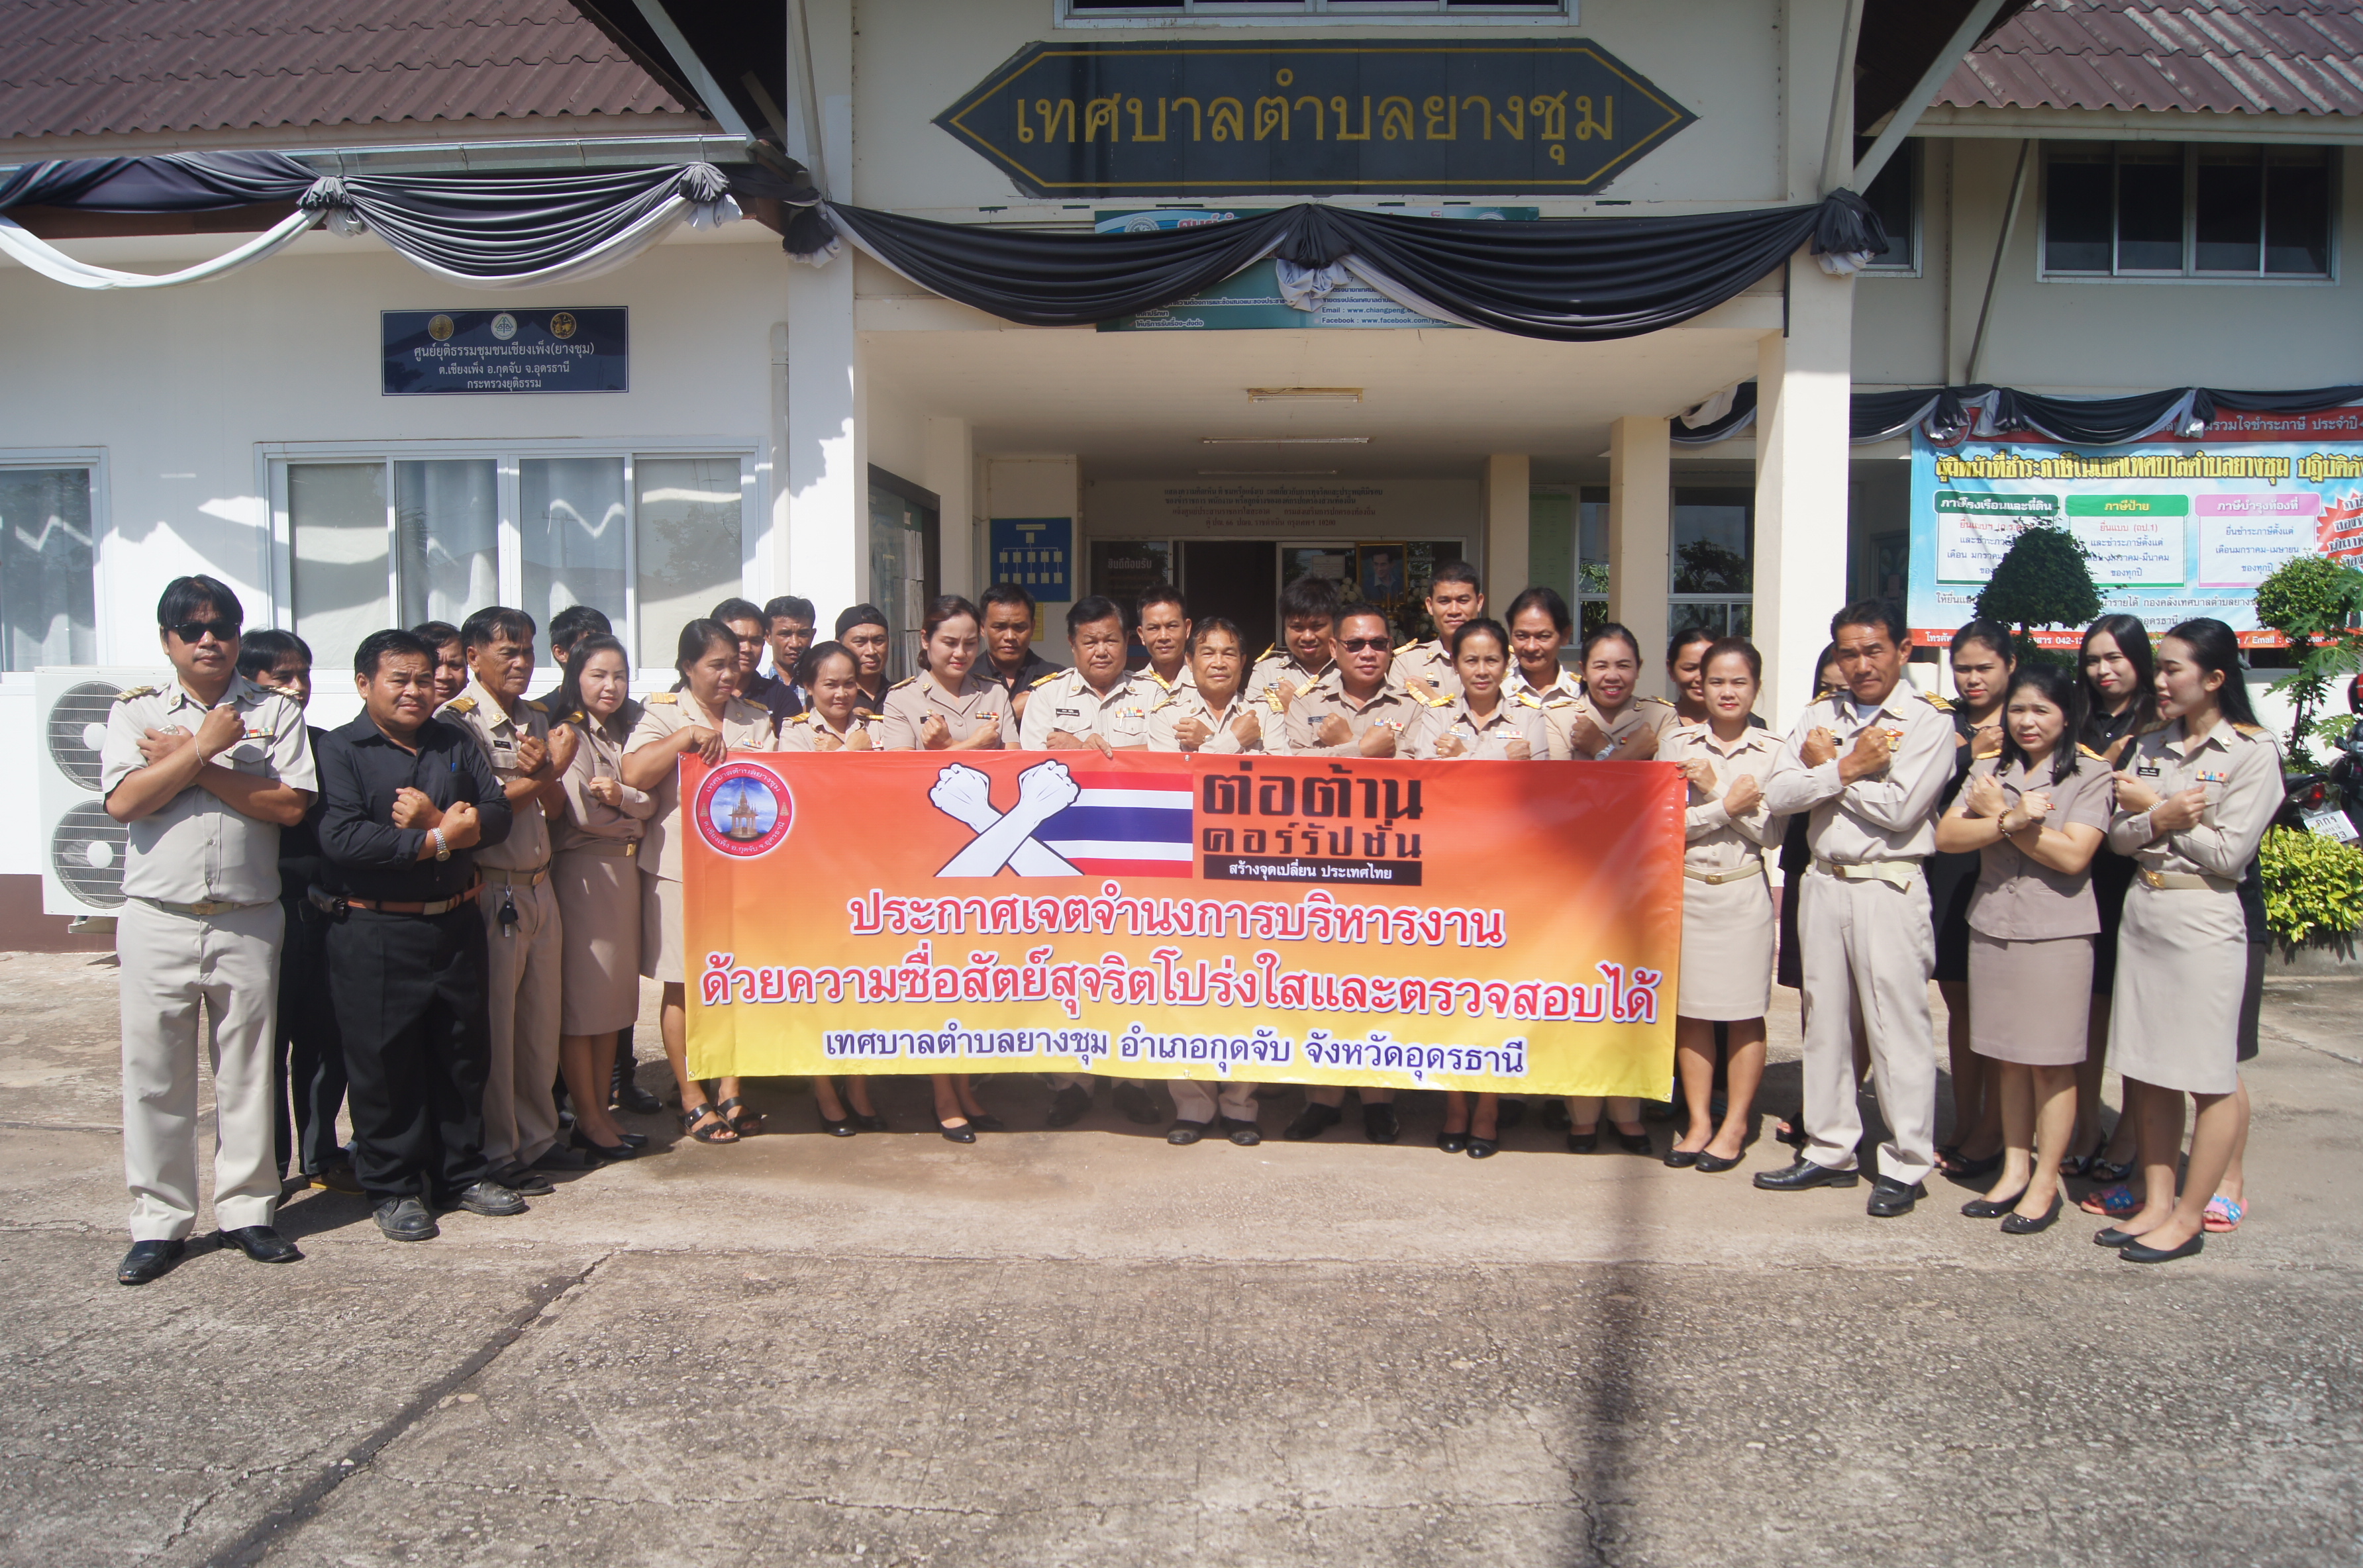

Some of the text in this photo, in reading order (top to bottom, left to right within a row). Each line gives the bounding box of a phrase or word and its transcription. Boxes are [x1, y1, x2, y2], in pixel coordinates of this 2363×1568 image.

[1017, 68, 1614, 166] เทศบาลตำบลยางชุม
[414, 340, 595, 361] ศูนย์ยุติธรรมชุมชนเชียงเพ็ง(ยางชุม)
[439, 361, 570, 377] ต.เชียงเพ็ง อ.กุดจับ จ.อุดรธานี
[467, 378, 542, 392] กระทรวงยุติธรรม
[2104, 499, 2150, 511] ภาษีป้าย
[2100, 520, 2129, 531] ยื่นแบบ
[1947, 549, 1967, 558] เดือน
[1107, 558, 1152, 569] ยินดีต้อนรับ
[2240, 564, 2273, 574] ของทุกปี
[2111, 567, 2142, 579] ของทุกปี
[2252, 635, 2275, 644] Email
[1203, 761, 1424, 820] ต่อต้าน
[1229, 859, 1392, 881] สร้างจุดเปลี่ยน ประเทศไทย
[849, 883, 1505, 946] ประกาศเจตจำนงการบริหารงาน
[701, 942, 1658, 1022] ด้วยความซื่อสัตย์สุจริตโปร่งใสและตรวจสอบได้
[826, 1022, 1525, 1081] เทศบาลตำบลยางชุม อำเภอกุดจับ จังหวัดอุดรธานี
